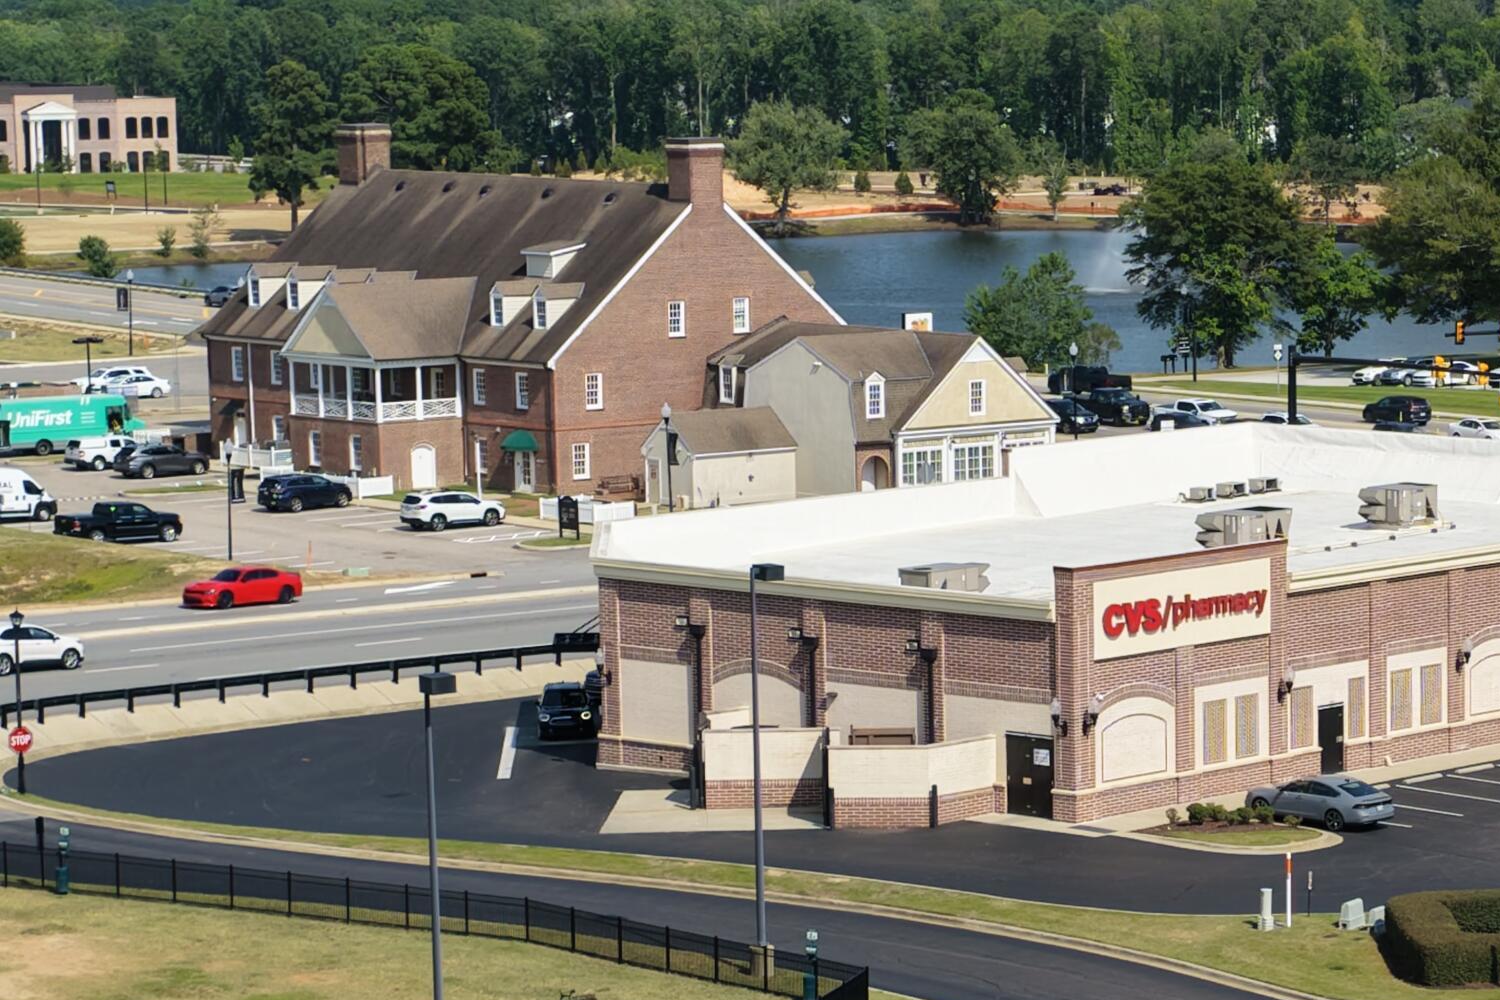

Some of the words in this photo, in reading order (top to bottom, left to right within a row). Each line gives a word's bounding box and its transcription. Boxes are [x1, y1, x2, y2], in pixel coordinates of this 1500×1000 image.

[7, 409, 73, 428] UniFirst
[1102, 588, 1268, 638] CVS/pharmacy
[10, 734, 31, 747] STOP
